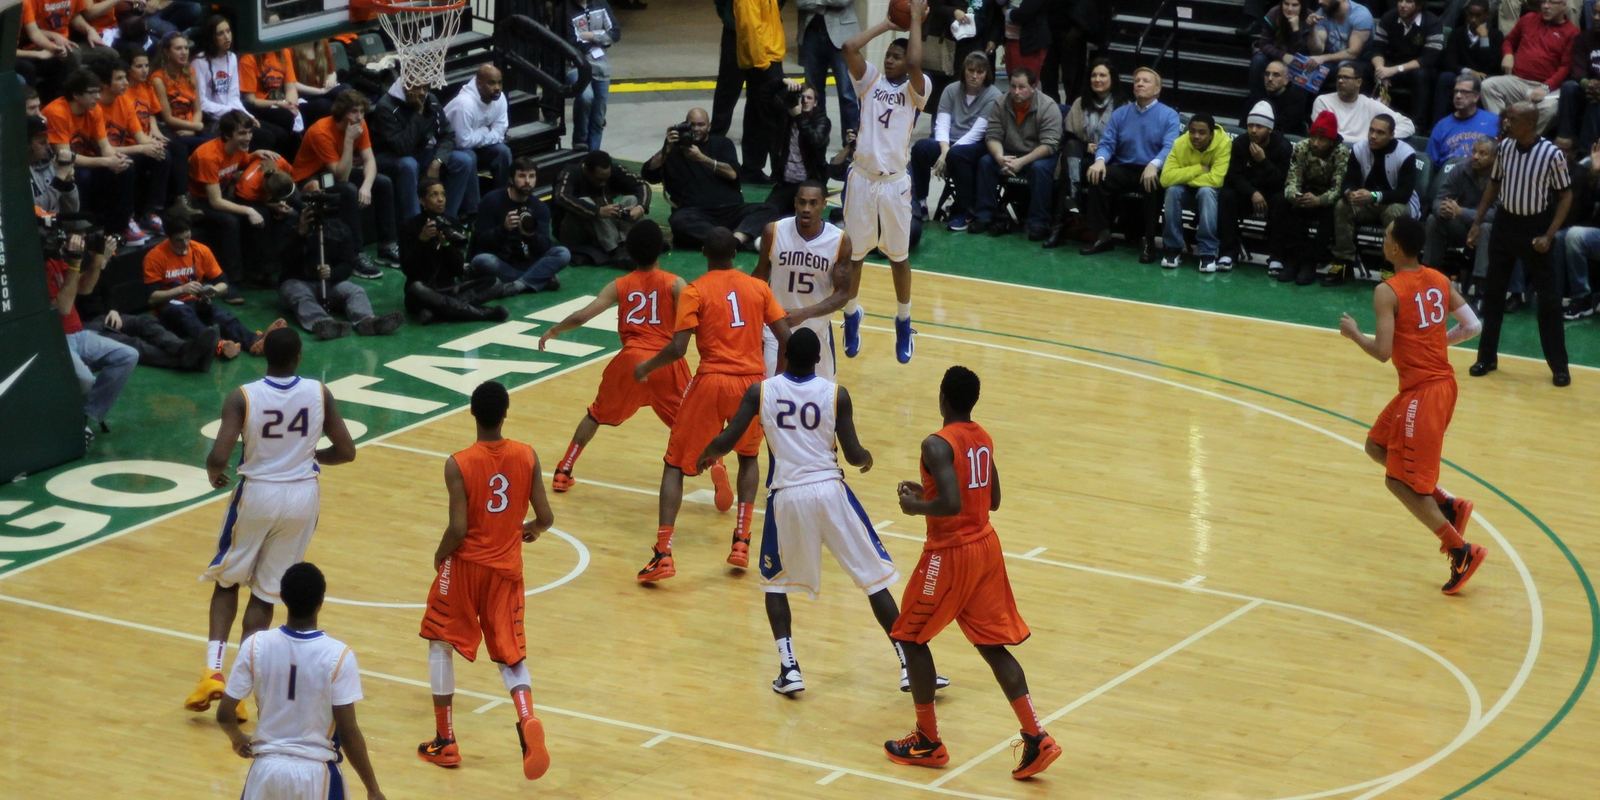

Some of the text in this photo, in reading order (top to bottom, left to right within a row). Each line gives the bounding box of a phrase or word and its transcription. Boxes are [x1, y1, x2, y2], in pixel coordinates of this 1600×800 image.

[878, 108, 894, 129] 4
[779, 250, 830, 272] SIMEON
[788, 270, 815, 294] 15
[626, 290, 662, 326] 21
[726, 290, 746, 329] 1
[1414, 287, 1446, 330] 13
[262, 407, 309, 439] 24
[776, 399, 821, 431] 20
[966, 446, 991, 490] 10
[486, 473, 510, 514] 3
[922, 554, 943, 597] DOLPHINS
[287, 663, 297, 702] 1
